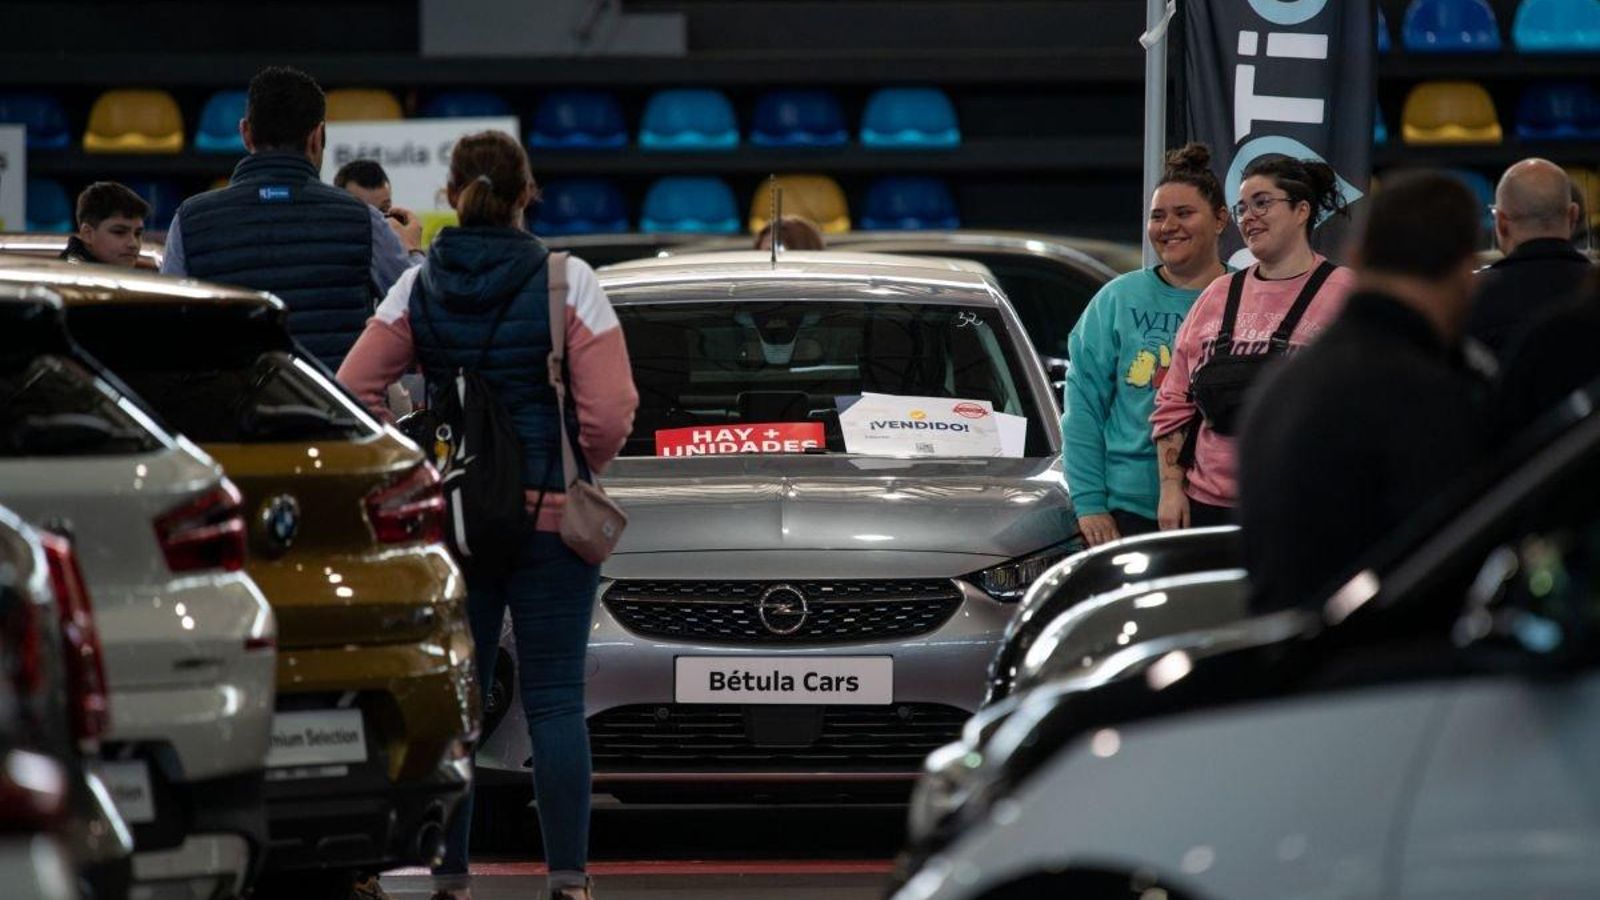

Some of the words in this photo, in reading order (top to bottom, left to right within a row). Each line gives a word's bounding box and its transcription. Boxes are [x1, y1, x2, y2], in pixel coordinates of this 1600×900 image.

[869, 420, 970, 433] ¡VENDIDO!
[692, 428, 754, 443] HAY
[662, 439, 819, 457] UNIDADES
[708, 670, 795, 692] Bétula
[803, 672, 860, 692] Cars
